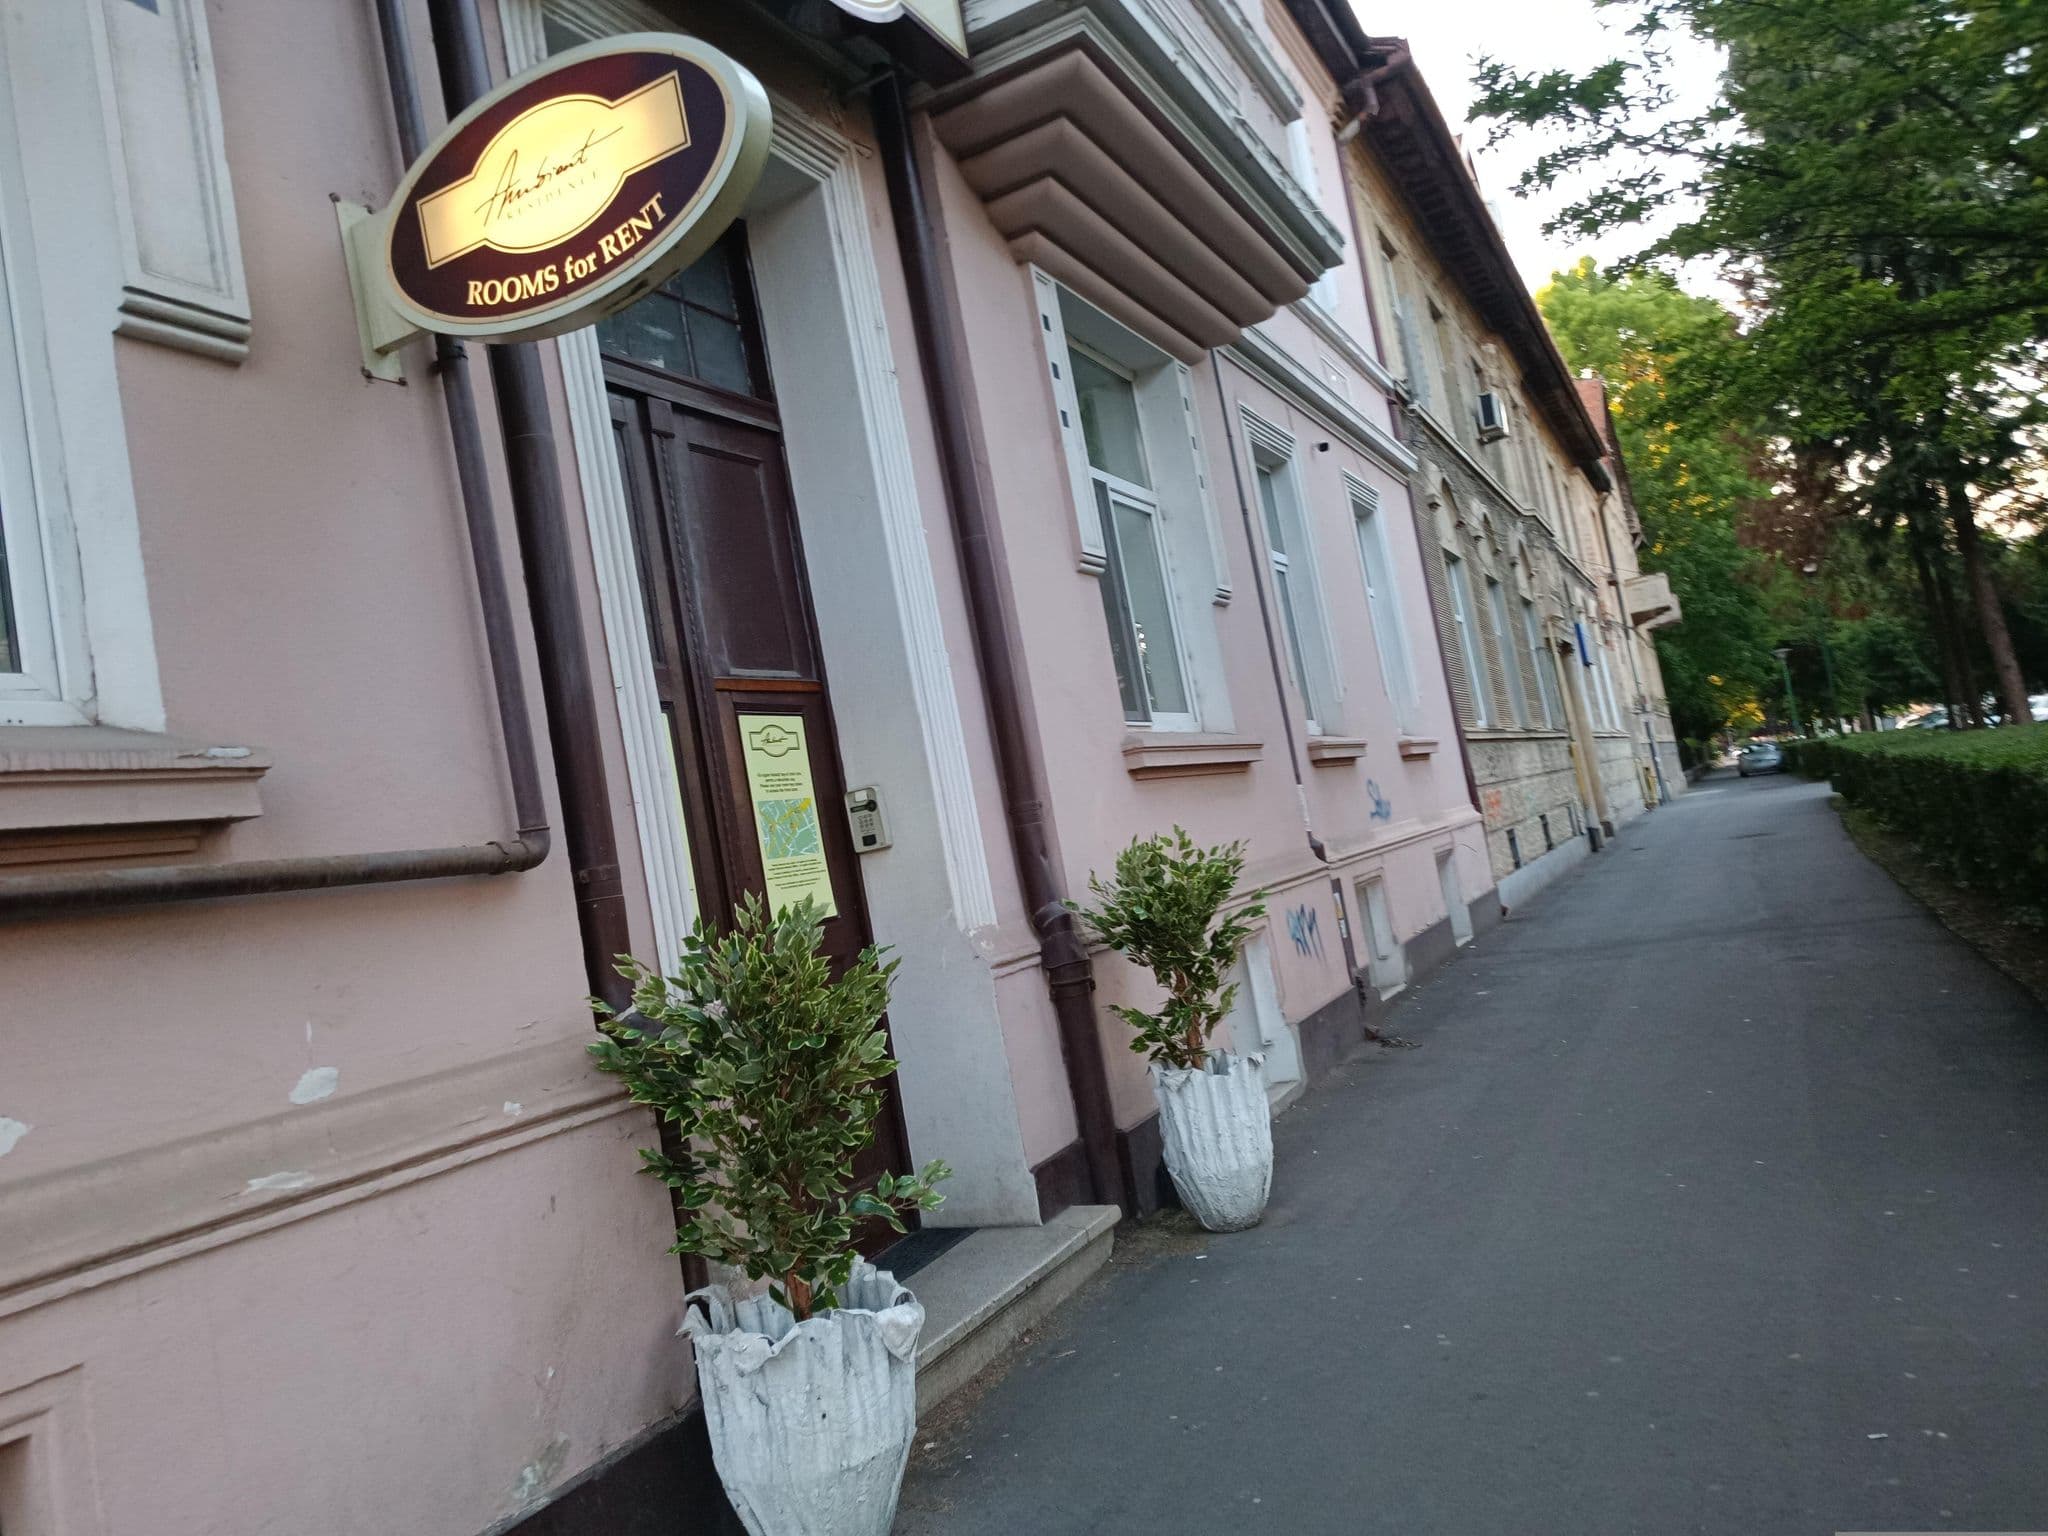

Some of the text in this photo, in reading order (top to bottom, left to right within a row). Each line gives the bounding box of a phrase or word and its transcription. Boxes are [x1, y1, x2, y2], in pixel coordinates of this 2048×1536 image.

[466, 192, 666, 306] ROOMS for RENT
